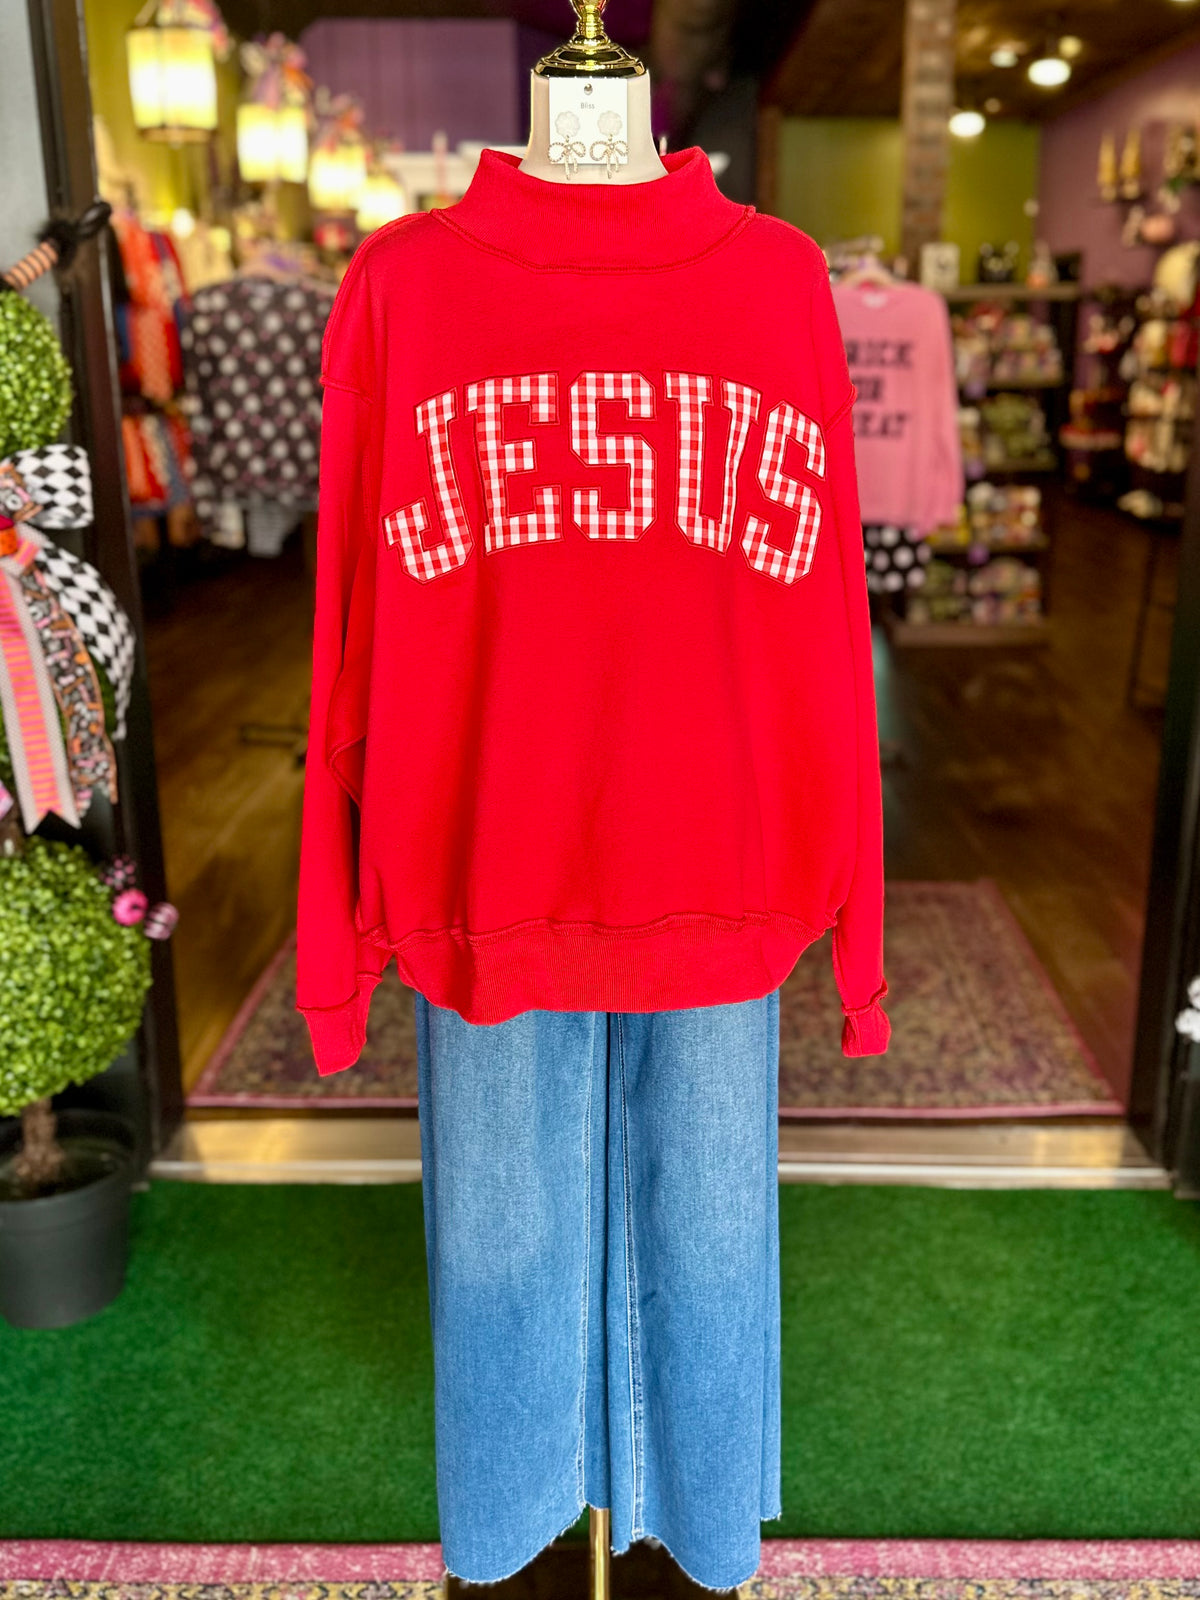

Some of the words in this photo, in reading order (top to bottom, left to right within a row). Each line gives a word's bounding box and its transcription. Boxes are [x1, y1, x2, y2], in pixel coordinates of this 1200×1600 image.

[580, 102, 596, 110] Bliss
[844, 338, 914, 368] RICK
[383, 370, 826, 585] JESUS
